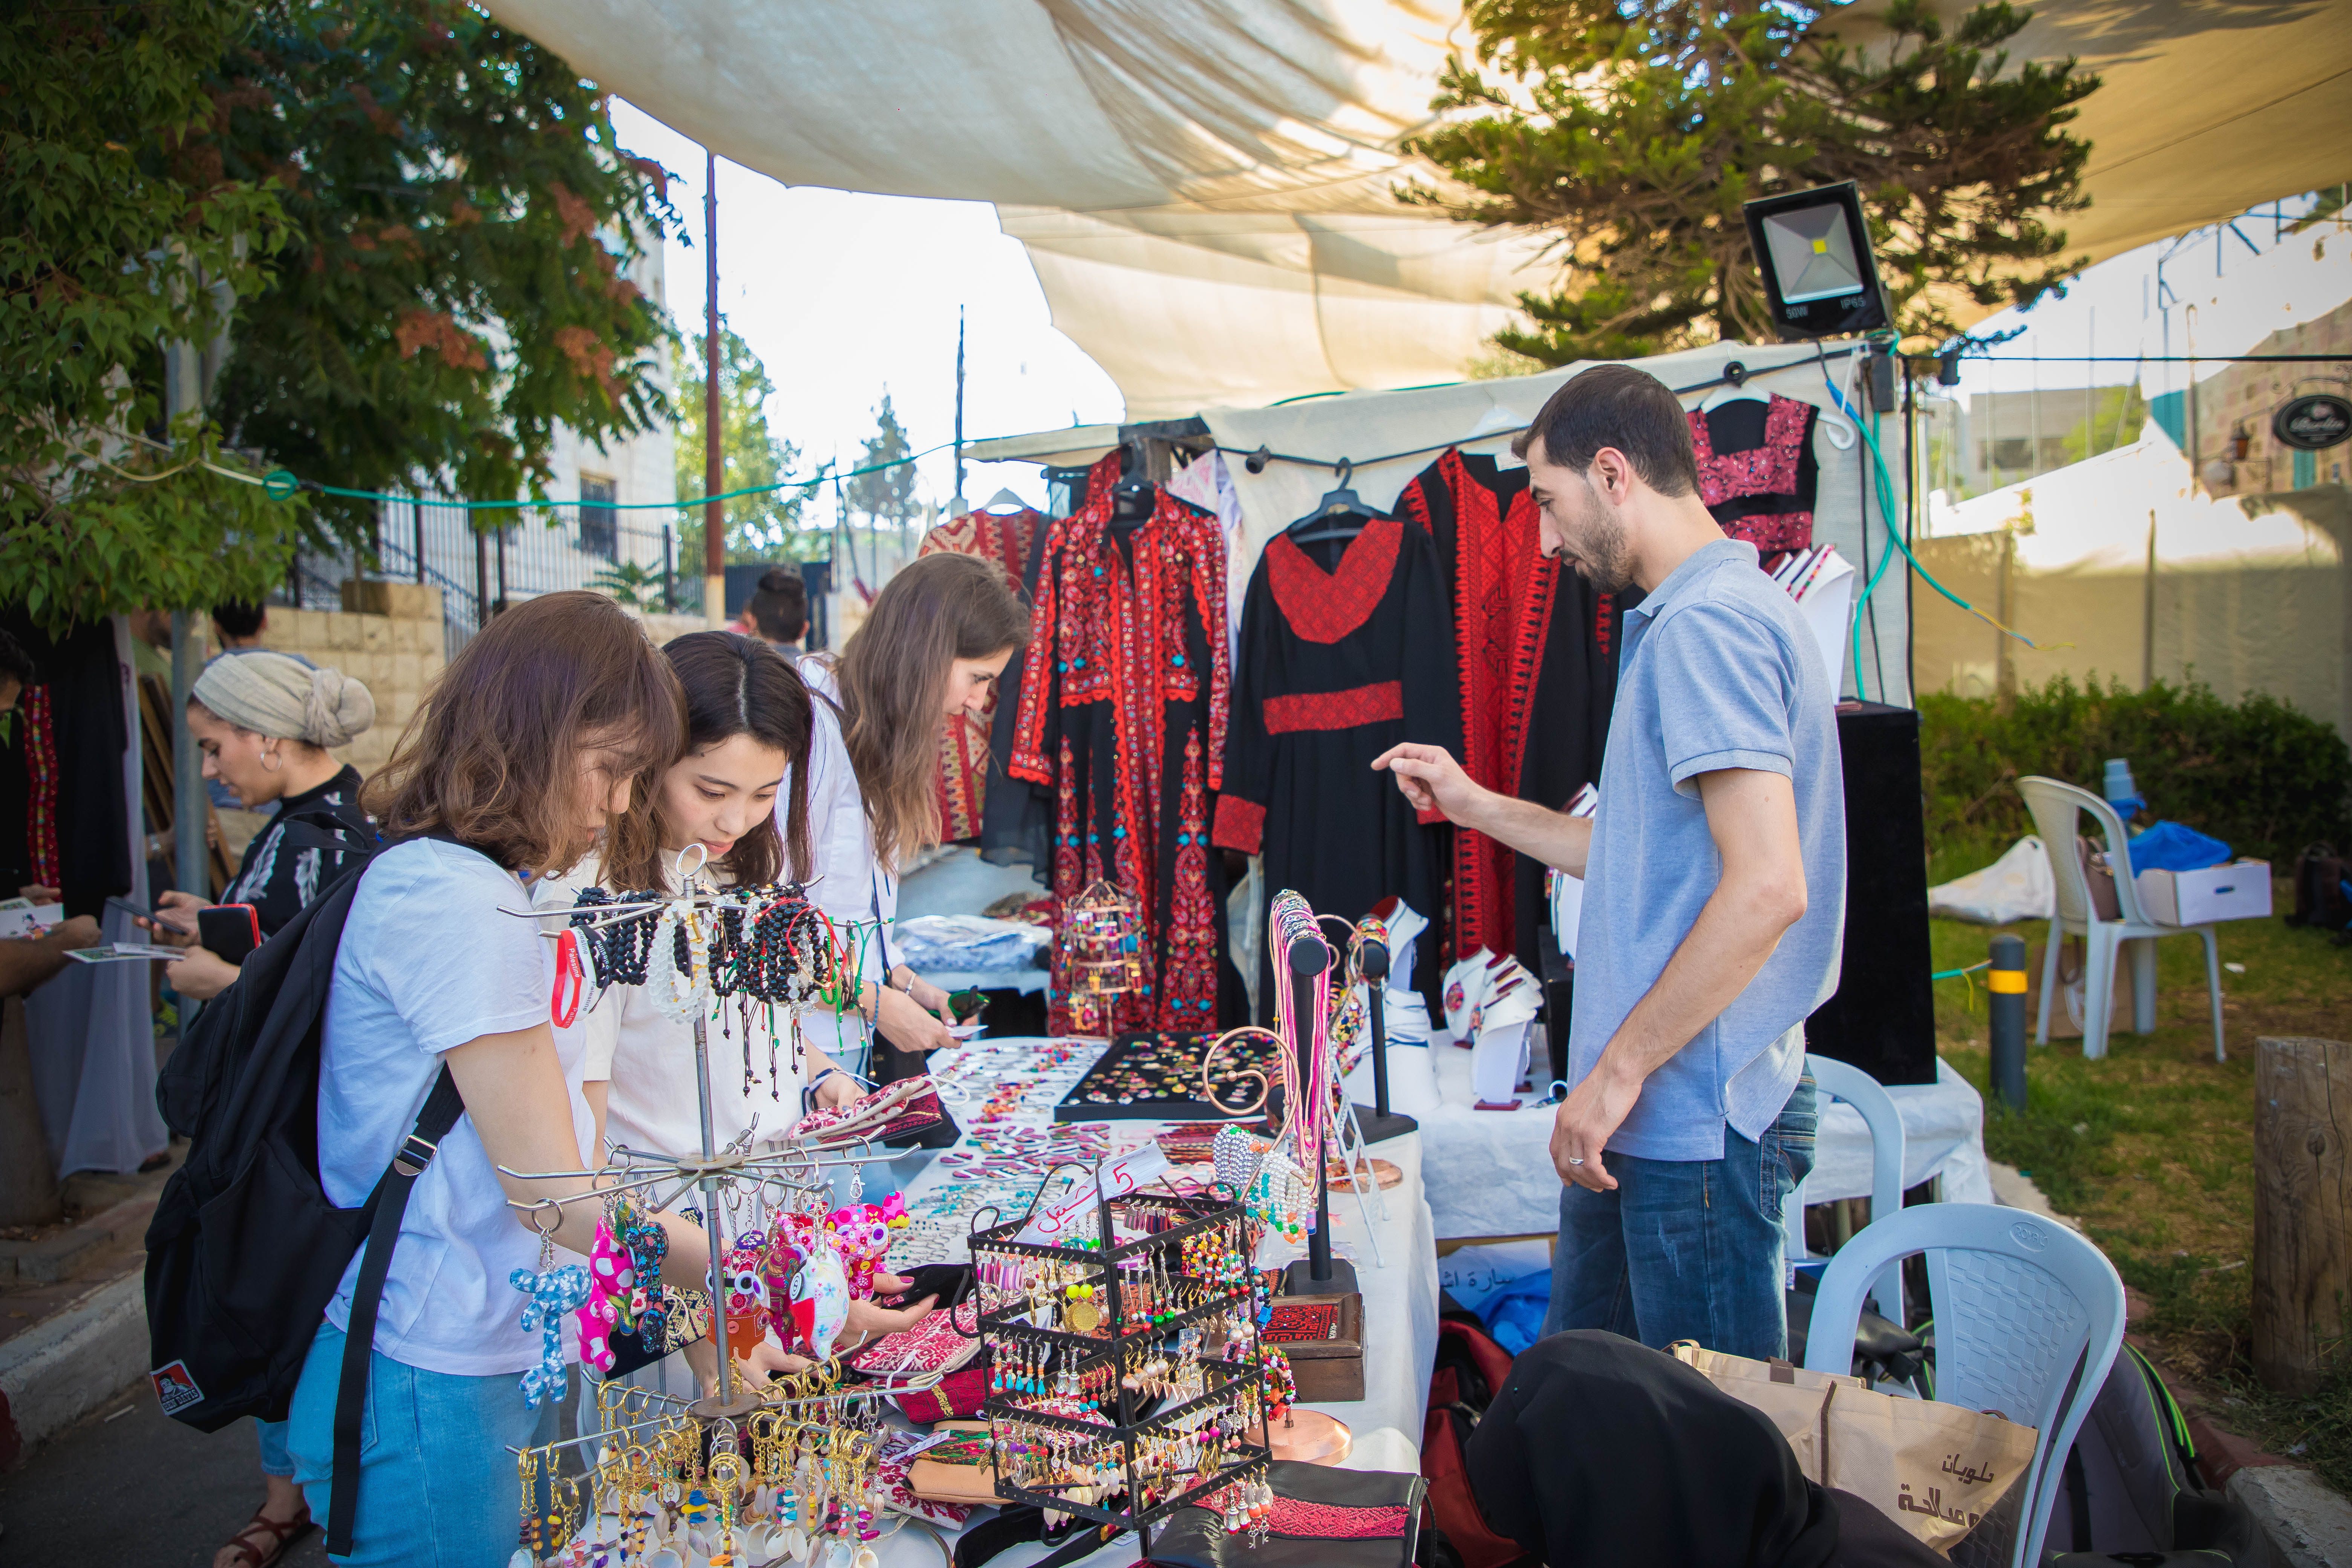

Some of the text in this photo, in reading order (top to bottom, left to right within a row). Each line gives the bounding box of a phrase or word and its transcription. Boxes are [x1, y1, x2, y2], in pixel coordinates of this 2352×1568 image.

[1840, 295, 1865, 309] IP65
[1113, 1162, 1133, 1193] 5
[2015, 1225, 2045, 1246] ROYAL
[162, 1389, 198, 1410] BEN DAVIS
[1942, 1453, 1994, 1484] حلويات
